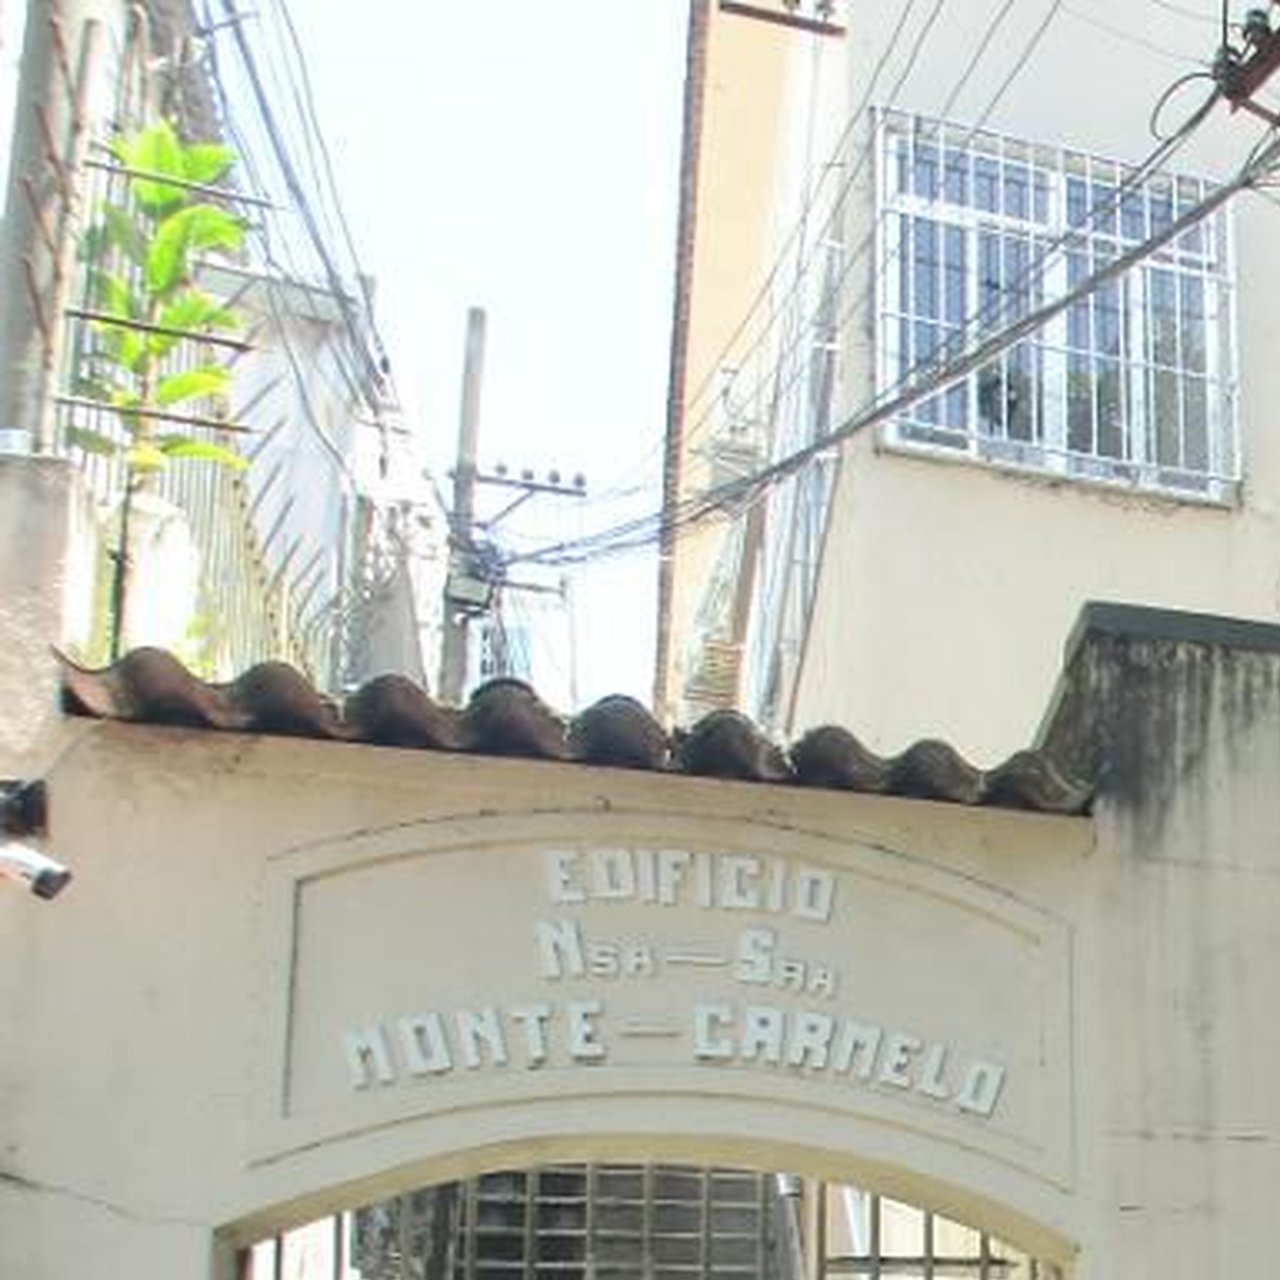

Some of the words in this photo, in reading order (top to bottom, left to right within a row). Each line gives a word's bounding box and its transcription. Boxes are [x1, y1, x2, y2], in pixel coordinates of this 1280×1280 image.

[547, 850, 835, 924] EDIFICIO
[346, 999, 606, 1091] MONTE
[694, 1002, 1005, 1118] CARMELO
